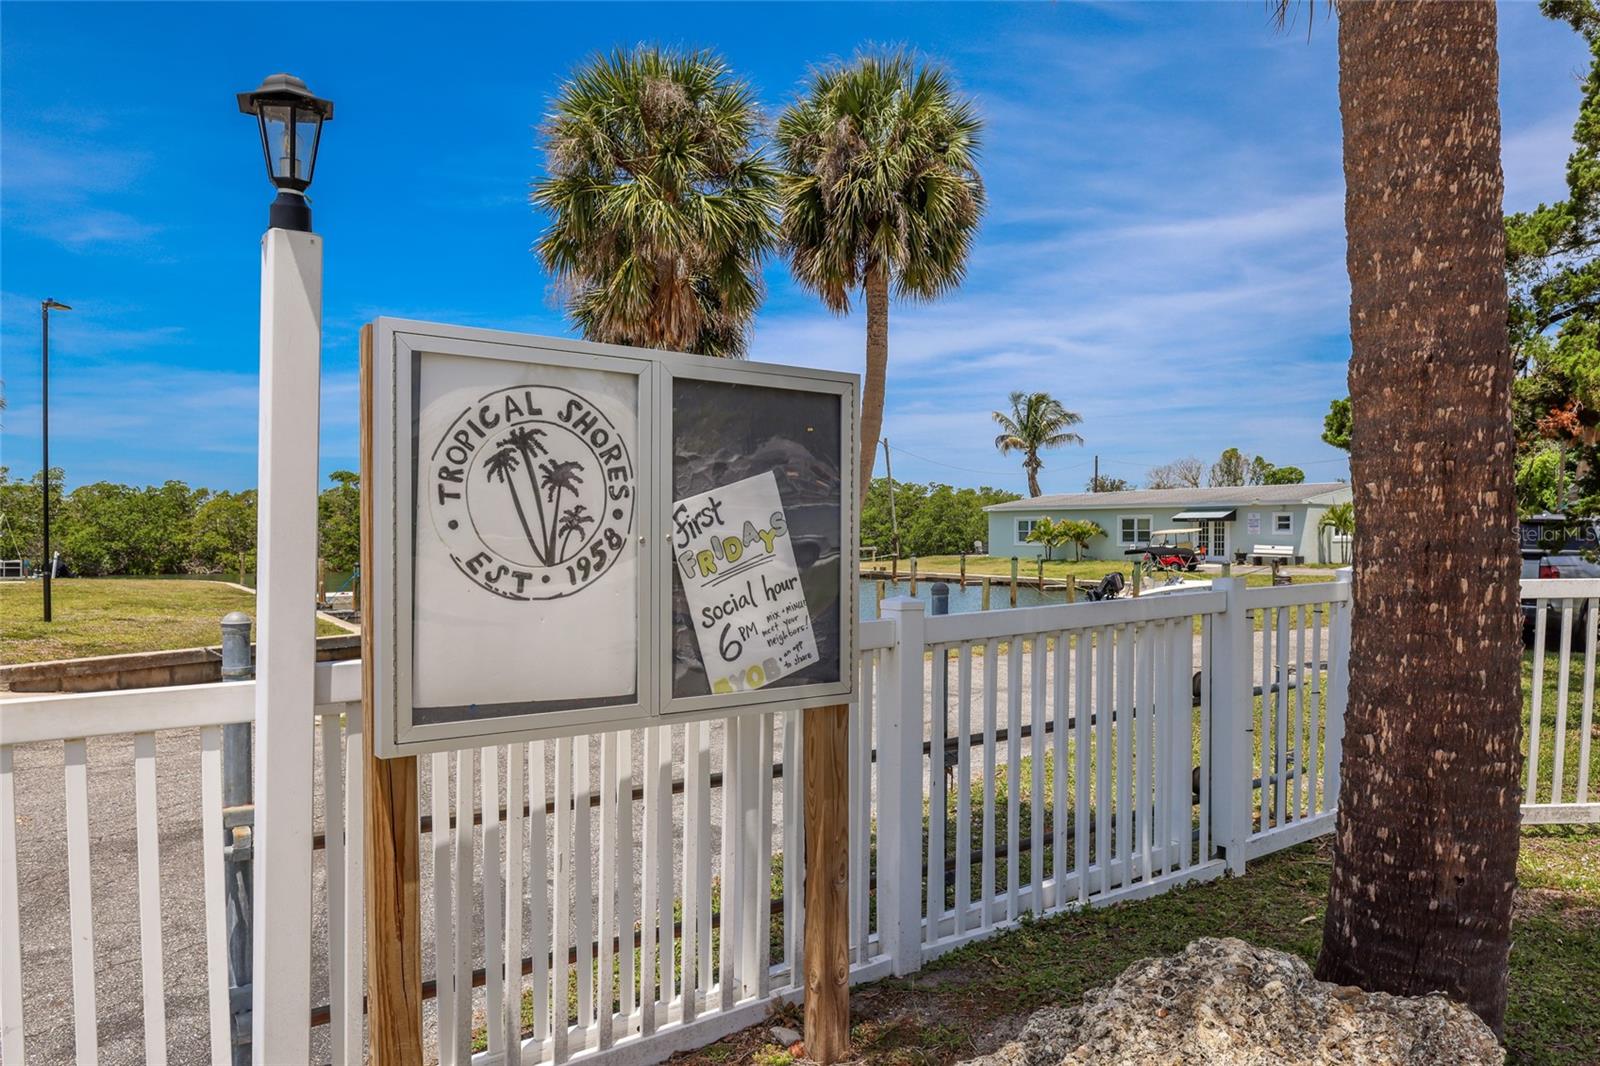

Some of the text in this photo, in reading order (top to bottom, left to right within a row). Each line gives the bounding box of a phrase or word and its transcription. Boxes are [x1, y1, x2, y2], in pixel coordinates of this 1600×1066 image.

[438, 391, 630, 505] TROPICAL SHORES
[465, 527, 622, 593] EST 1958
[678, 511, 788, 579] FRIDAYS
[761, 574, 798, 601] hour
